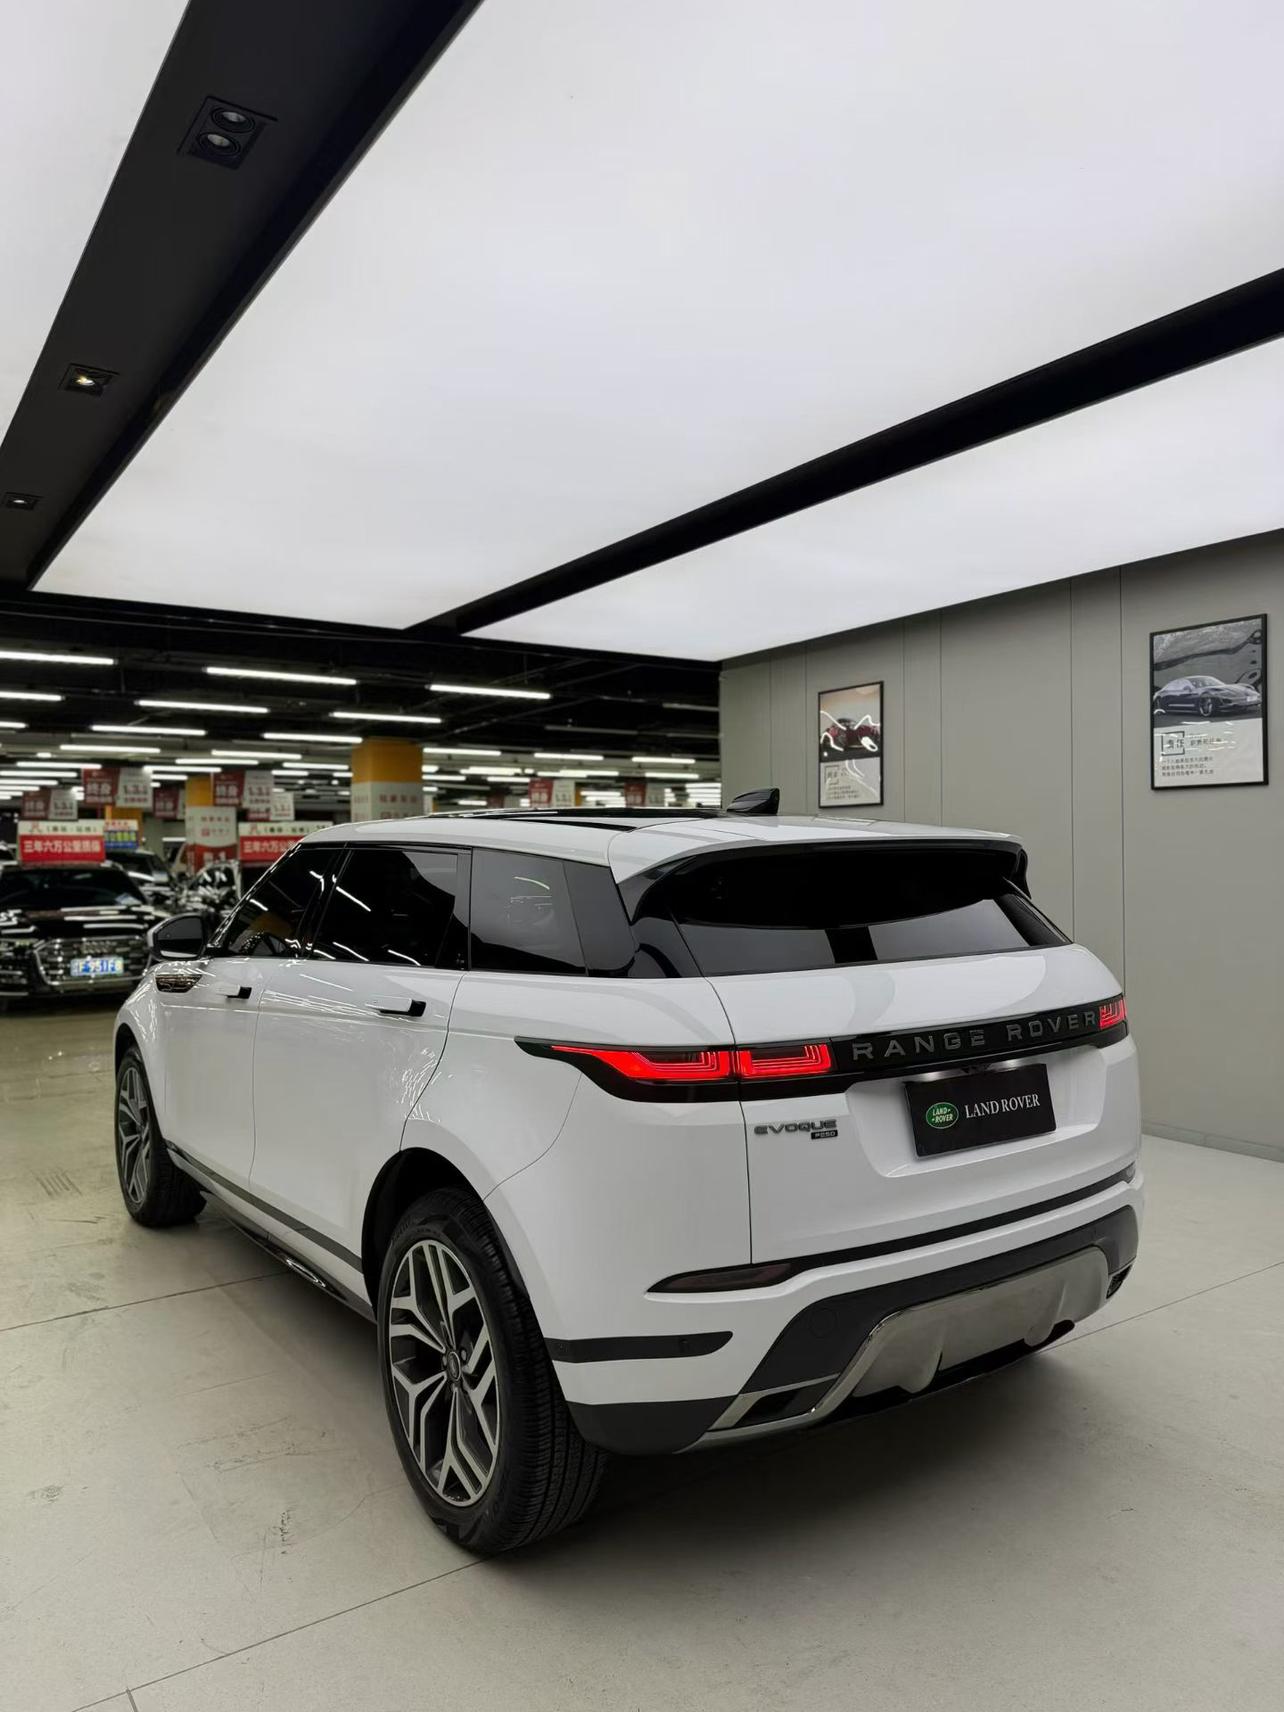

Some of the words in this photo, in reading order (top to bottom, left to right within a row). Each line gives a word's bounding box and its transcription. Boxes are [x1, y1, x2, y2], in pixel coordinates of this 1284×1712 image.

[851, 1029, 986, 1061] RANGE
[1007, 1010, 1097, 1042] ROVER
[964, 1100, 999, 1118] LAND
[1001, 1093, 1041, 1113] ROVER
[754, 1119, 837, 1135] EVOQUE
